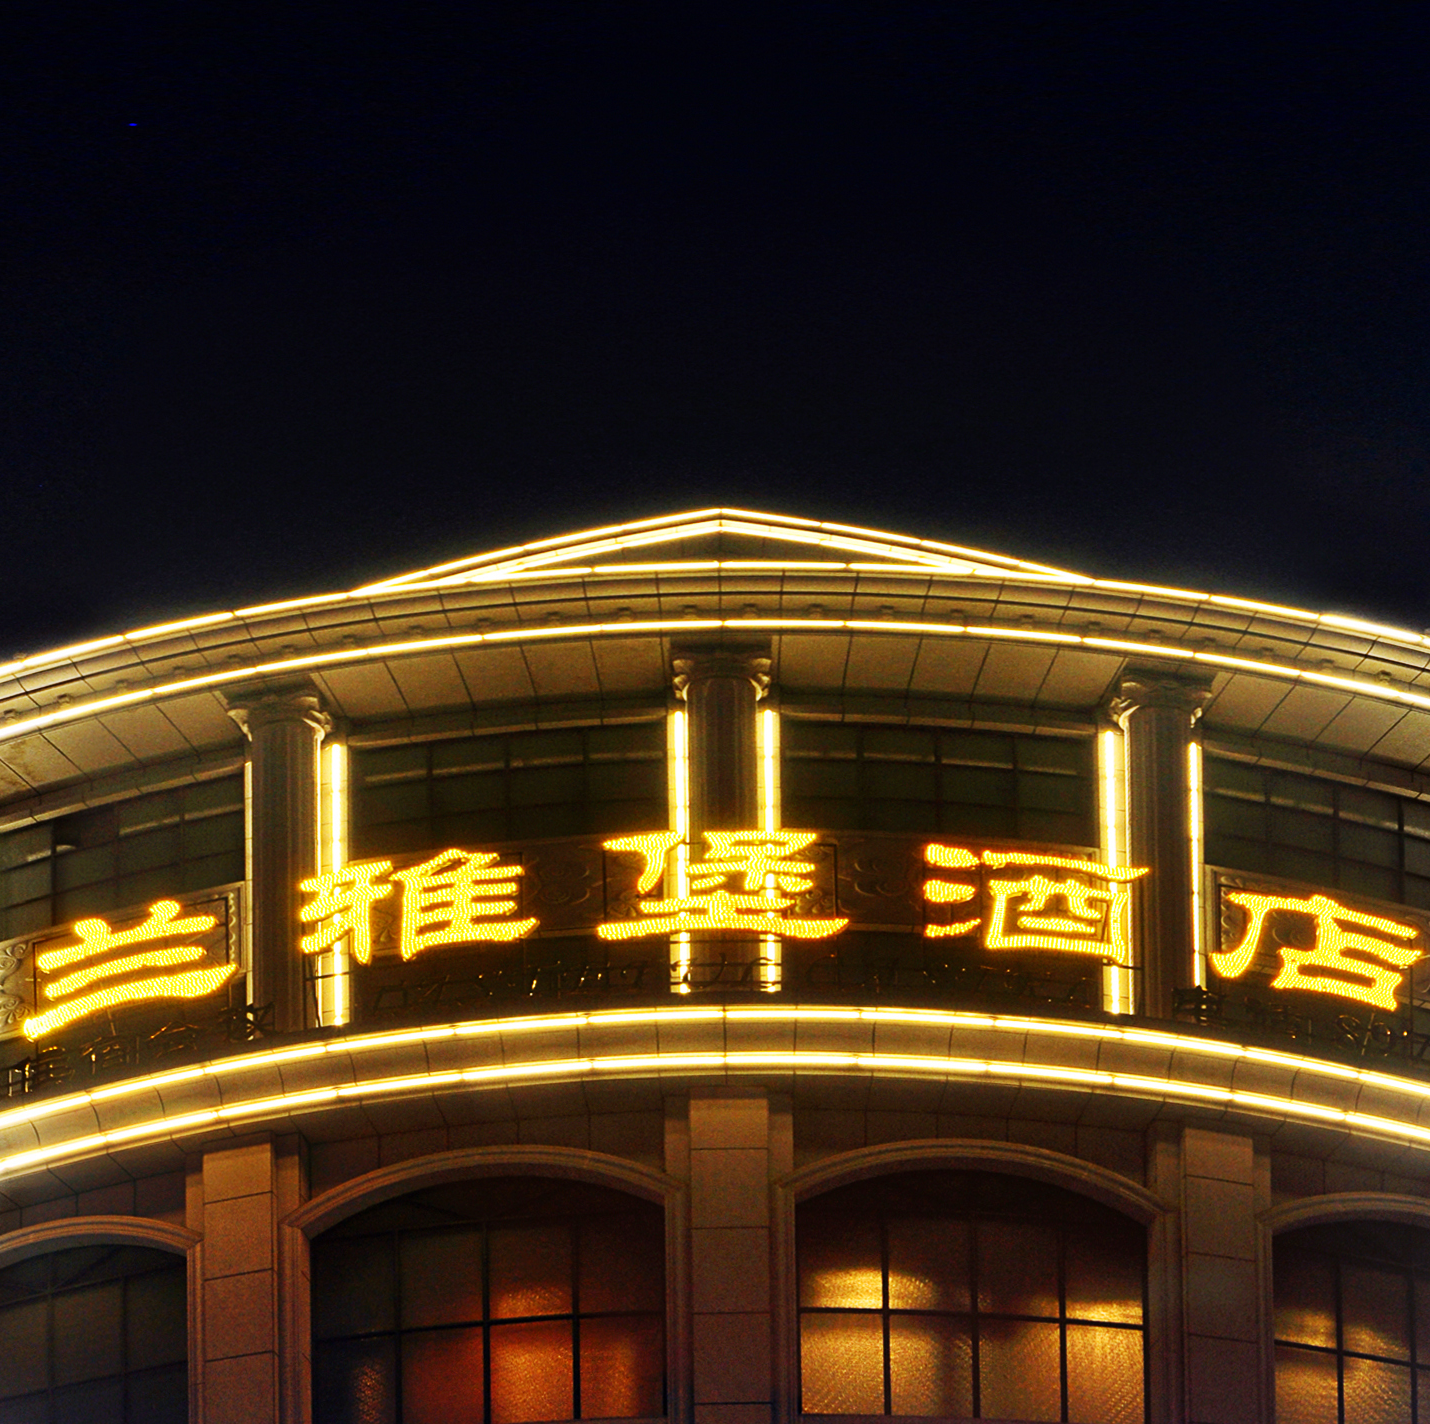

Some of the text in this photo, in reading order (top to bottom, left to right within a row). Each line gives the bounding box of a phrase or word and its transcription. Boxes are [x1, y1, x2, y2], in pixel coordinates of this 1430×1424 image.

[21, 828, 1426, 1040] 兰雅堡酒店
